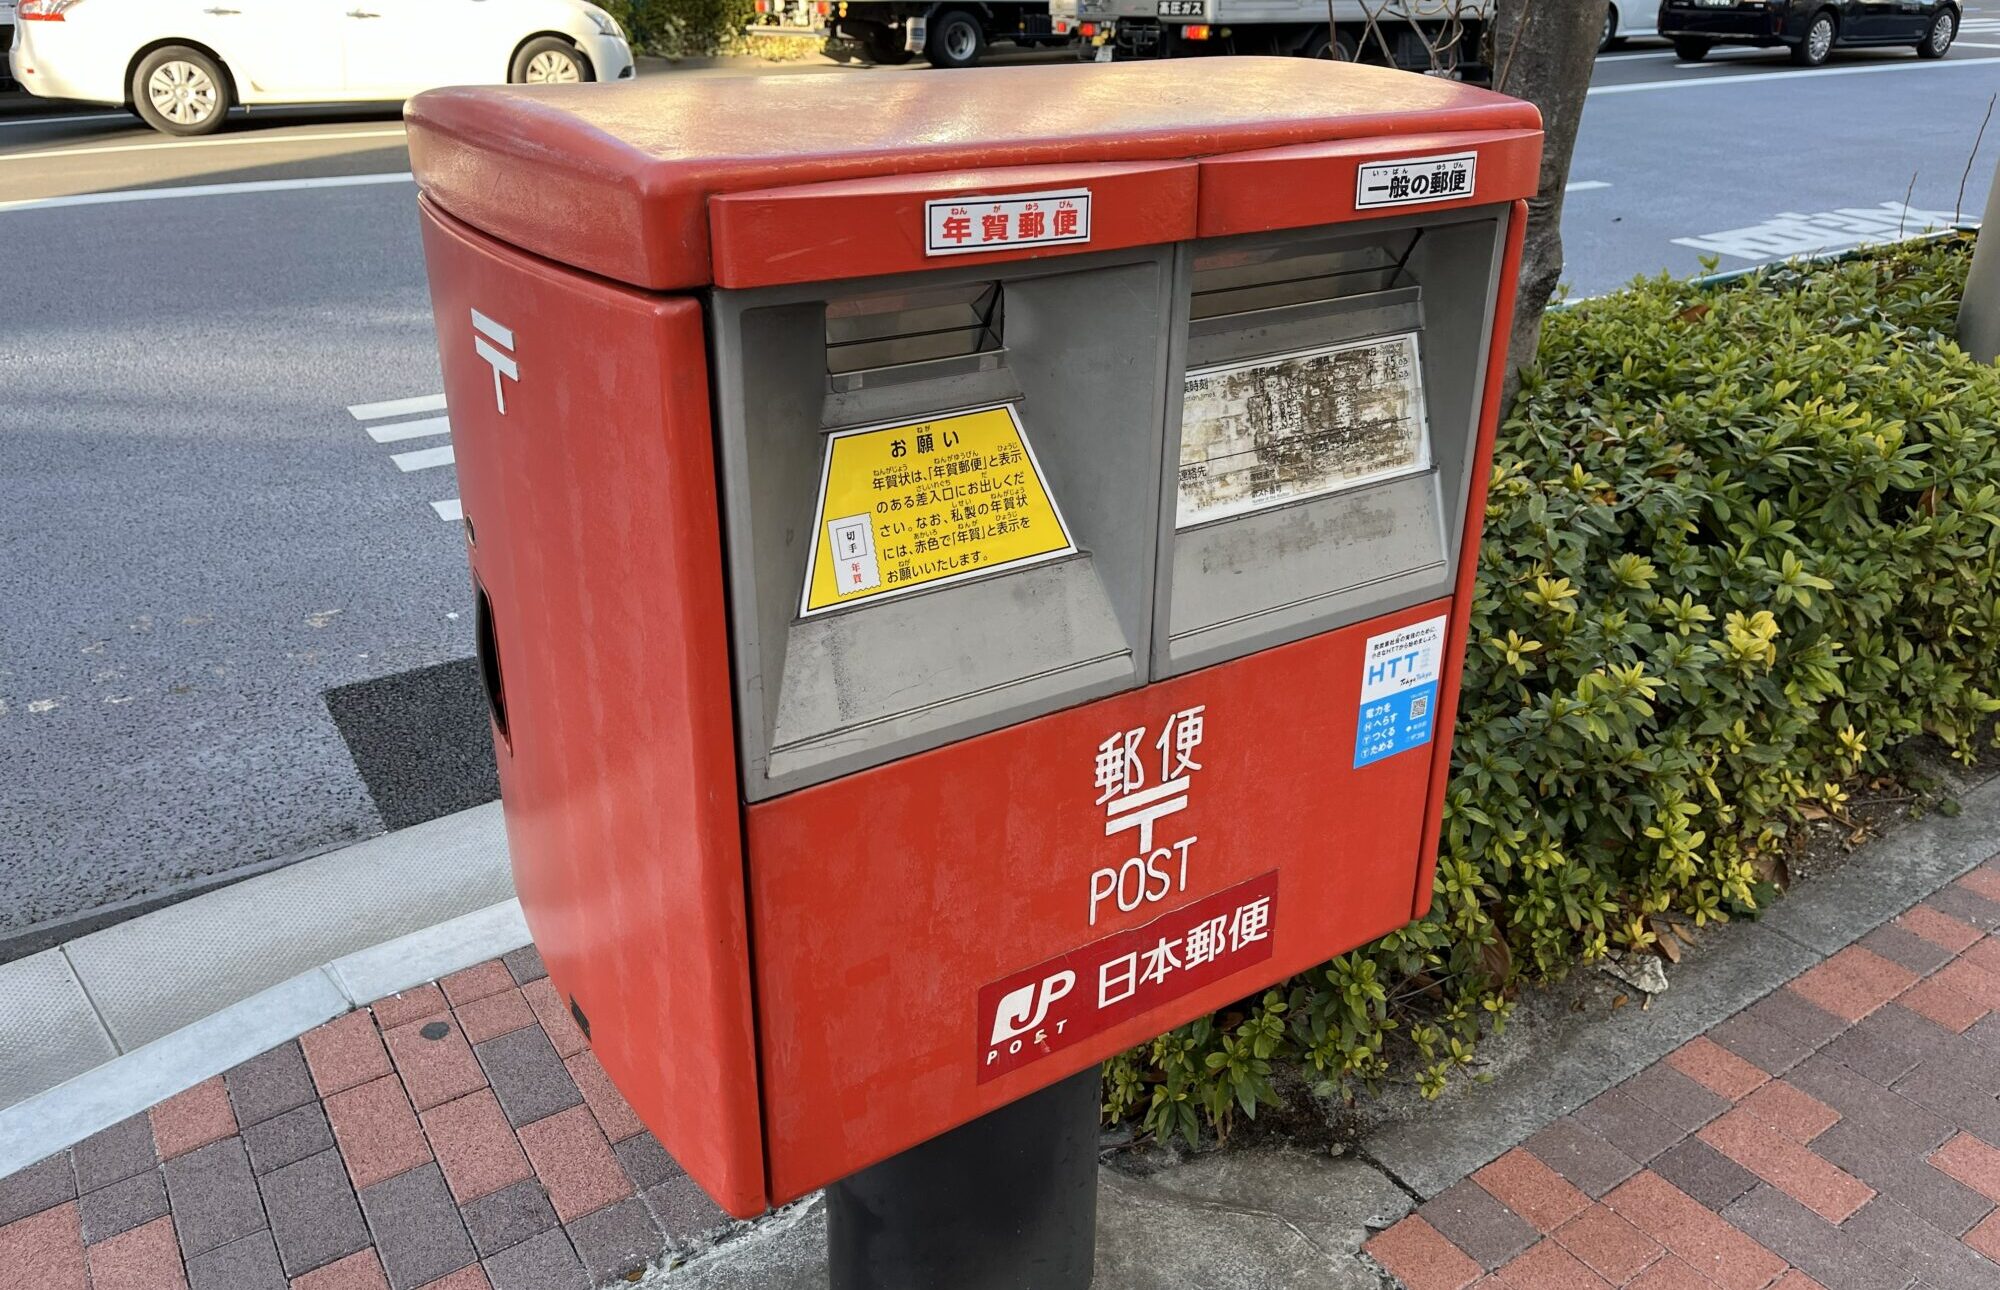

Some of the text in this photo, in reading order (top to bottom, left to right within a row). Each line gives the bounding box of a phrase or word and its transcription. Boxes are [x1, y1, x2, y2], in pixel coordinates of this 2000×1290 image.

[1159, 1, 1202, 15] 高圧ガス
[1368, 169, 1467, 199] 一般の郵便
[951, 201, 1074, 216] ねん が ゆう びん
[942, 210, 1079, 244] 年賀郵便
[890, 431, 960, 458] お願い
[917, 425, 931, 434] ねが
[872, 449, 1023, 492] 年賀状は、「年賀郵便」と表示
[873, 442, 1018, 477] ねんがじょう ねんがゆうびん ひょうじ
[876, 471, 1025, 515] のある差入口にお出しくだ
[916, 480, 951, 493] さしいれぐち
[951, 487, 1025, 509] しせい ねんがじょう
[879, 494, 1029, 539] さい。なお、私製の年賀状
[914, 512, 1018, 540] あかいろ ねんが ひょうじ
[846, 530, 858, 554] 切手
[883, 516, 1031, 561] には、赤色で「年賀」と表示を
[887, 550, 988, 584] お願いいたします。
[898, 558, 911, 567] ねが
[1368, 651, 1419, 686] HTT
[1372, 726, 1396, 741] つくる
[1373, 712, 1399, 726] へらす
[1094, 704, 1206, 806] 郵便
[1370, 739, 1394, 756] ためる
[1089, 836, 1198, 926] POST
[1098, 896, 1270, 1010] 日本郵便
[986, 1019, 1068, 1066] POST
